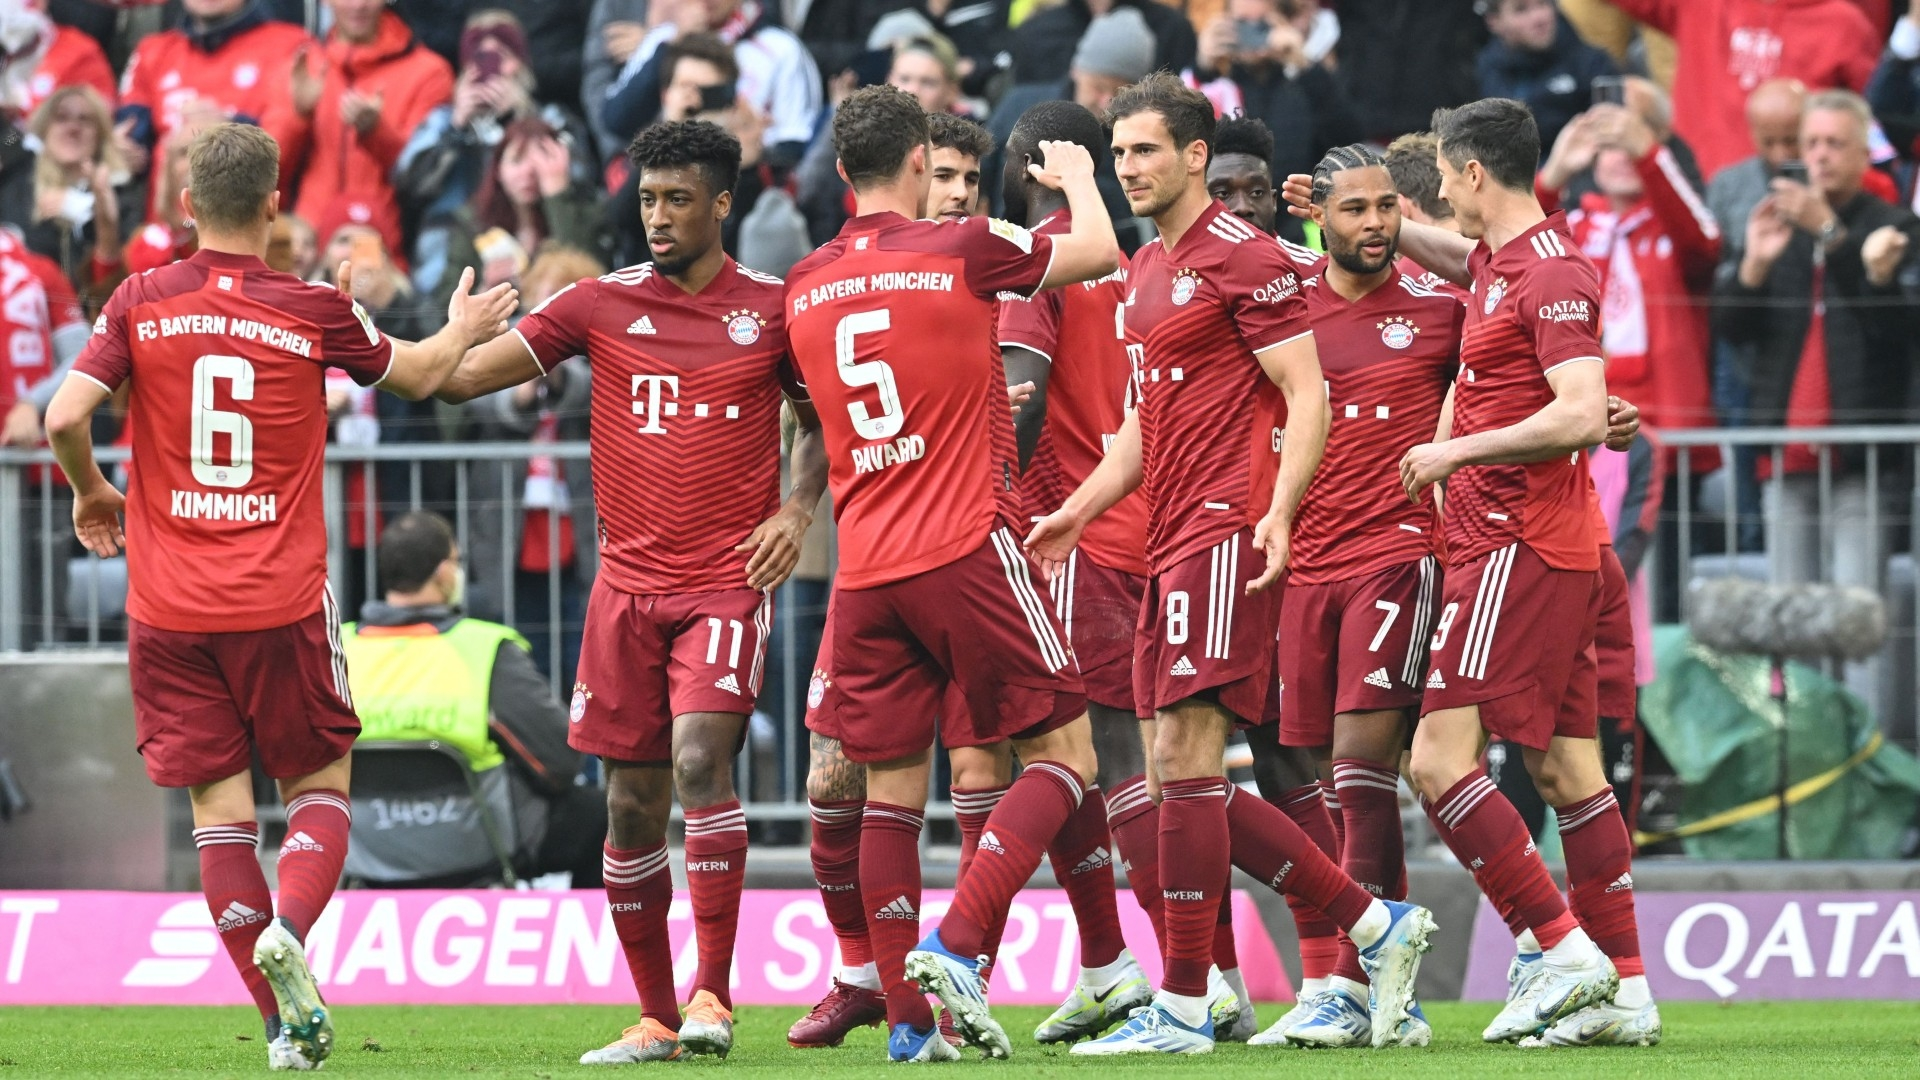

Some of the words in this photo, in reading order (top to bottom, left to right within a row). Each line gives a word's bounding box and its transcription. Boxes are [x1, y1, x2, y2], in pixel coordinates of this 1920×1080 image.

[793, 294, 809, 316] FC
[810, 276, 867, 307] BAYERN
[870, 272, 954, 292] MÜNCHEN
[1253, 272, 1297, 302] QATAR
[1271, 284, 1299, 305] AIRWAYS
[1538, 300, 1589, 319] QATAR
[1554, 312, 1589, 324] AIRWAYS
[137, 321, 158, 342] FC
[160, 315, 227, 338] BAYERN
[230, 319, 313, 359] MÜNCHEN
[835, 308, 905, 440] 5
[190, 354, 255, 488] 6
[851, 434, 926, 475] PAVARD
[171, 489, 277, 522] KIMMICH
[1166, 590, 1190, 645] 8
[1368, 599, 1400, 652] 7
[1430, 602, 1459, 651] 9
[705, 617, 744, 669] 11
[1170, 667, 1197, 676] adidas
[1363, 676, 1392, 690] adidas
[714, 681, 741, 696] adidas
[687, 861, 729, 871] BAYERN
[1268, 860, 1294, 889] YERN
[609, 902, 642, 912] YERN
[875, 911, 919, 921] adidas
[763, 898, 1081, 993] SRT
